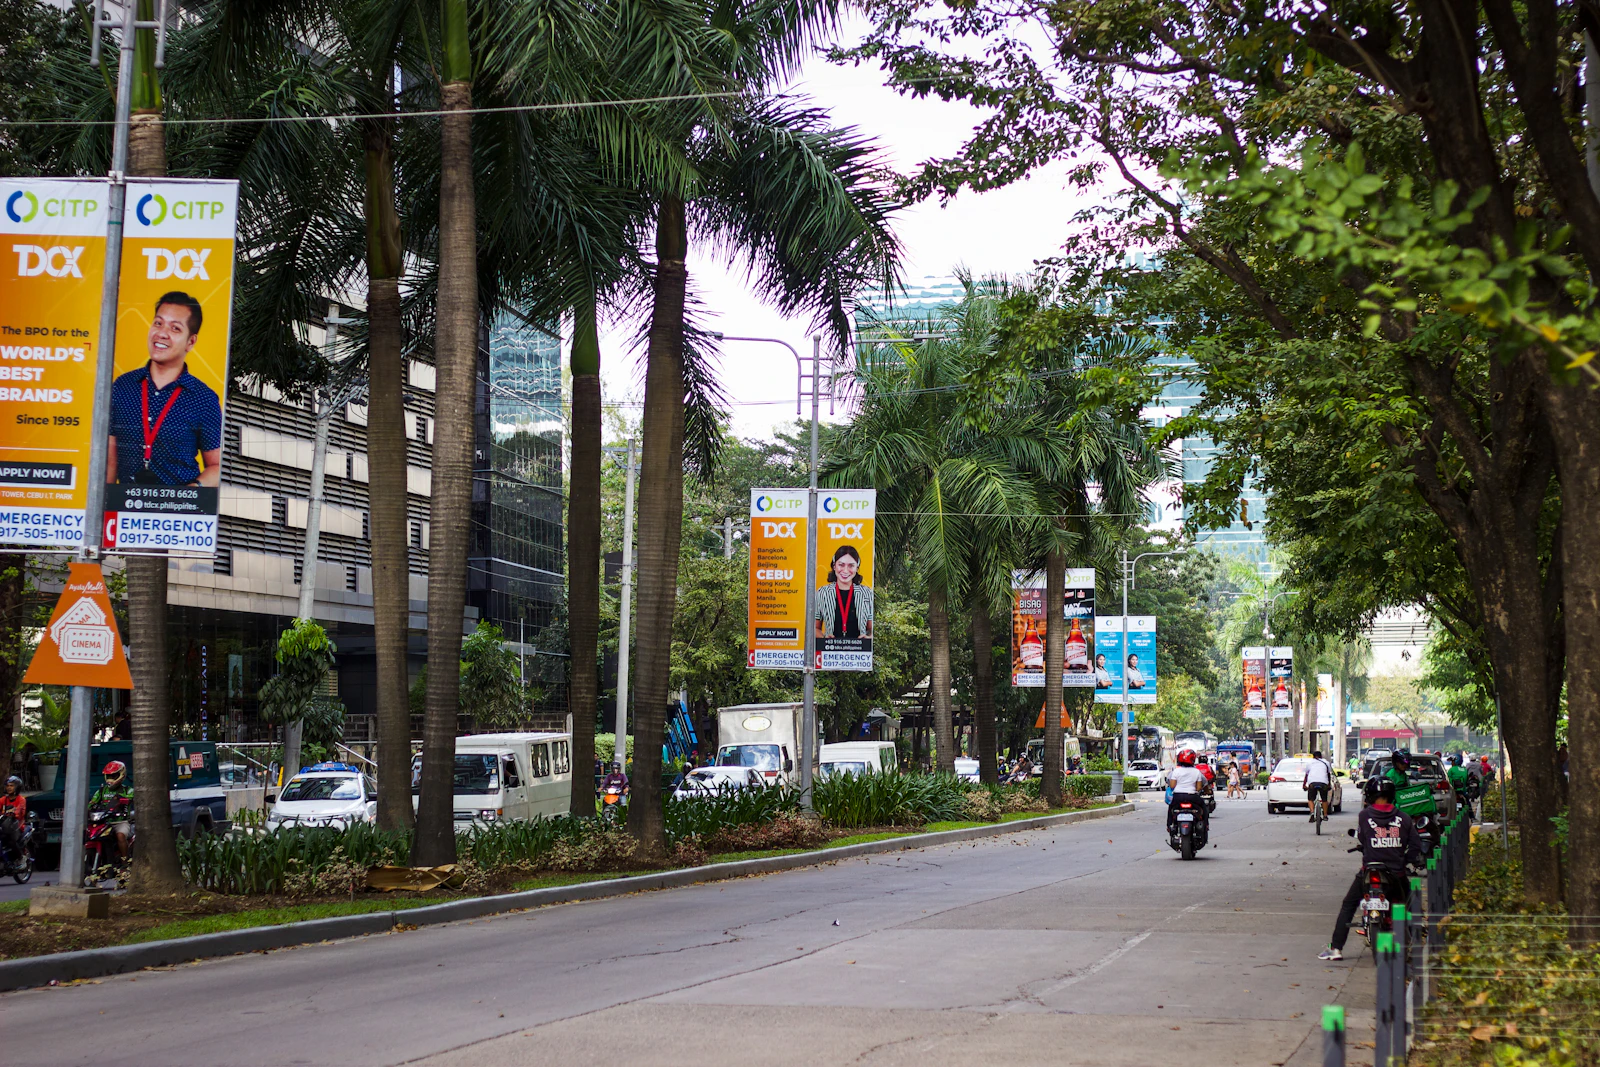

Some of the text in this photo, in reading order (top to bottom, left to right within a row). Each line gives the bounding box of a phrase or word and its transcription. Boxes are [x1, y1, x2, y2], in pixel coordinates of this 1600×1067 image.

[43, 198, 98, 218] CITP
[172, 200, 224, 220] CITP
[12, 244, 86, 278] TDCX
[142, 247, 212, 280] TDCX
[1, 326, 90, 337] The BPO for the
[0, 345, 85, 362] WORLD'S
[0, 366, 44, 381] BEST
[0, 387, 73, 404] BRANDS
[16, 414, 80, 426] Since 1995
[32, 469, 66, 479] NOW!
[1, 490, 26, 499] TOWER,
[125, 488, 198, 499] +63 916 378 6626
[775, 499, 803, 509] CITP
[841, 500, 869, 510] CITP
[121, 518, 214, 533] EMERGENCY
[760, 521, 797, 539] TDCX
[827, 522, 864, 540] TDCX
[119, 532, 213, 547] 0917-505-1100
[757, 561, 778, 569] Beijing
[756, 569, 794, 580] CEBU
[1072, 575, 1091, 583] CITP
[1019, 600, 1042, 609] BISAG
[71, 639, 102, 649] CINEMA
[756, 652, 804, 660] EMERGENCY
[823, 653, 871, 662] EMERGENCY
[756, 659, 804, 667] 0917-505-1100
[823, 661, 872, 669] 0917-505-1100
[1400, 789, 1426, 800] GrabFood
[1370, 837, 1402, 848] CASUAL
